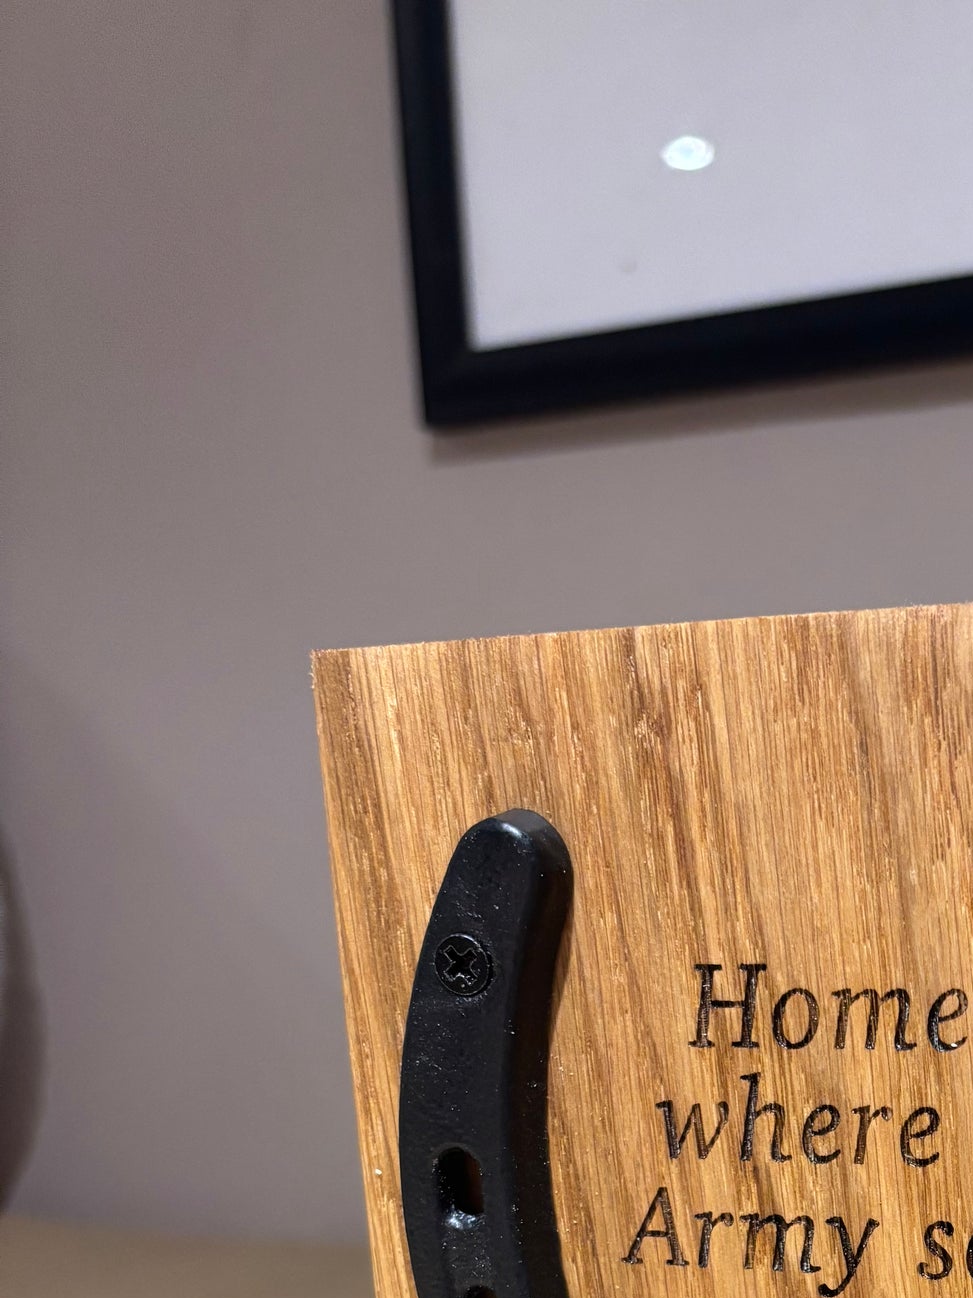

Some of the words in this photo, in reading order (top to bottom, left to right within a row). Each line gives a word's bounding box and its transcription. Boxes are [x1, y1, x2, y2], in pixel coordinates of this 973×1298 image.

[689, 962, 968, 1053] Home
[655, 1071, 941, 1167] where
[621, 1187, 879, 1298] Army
